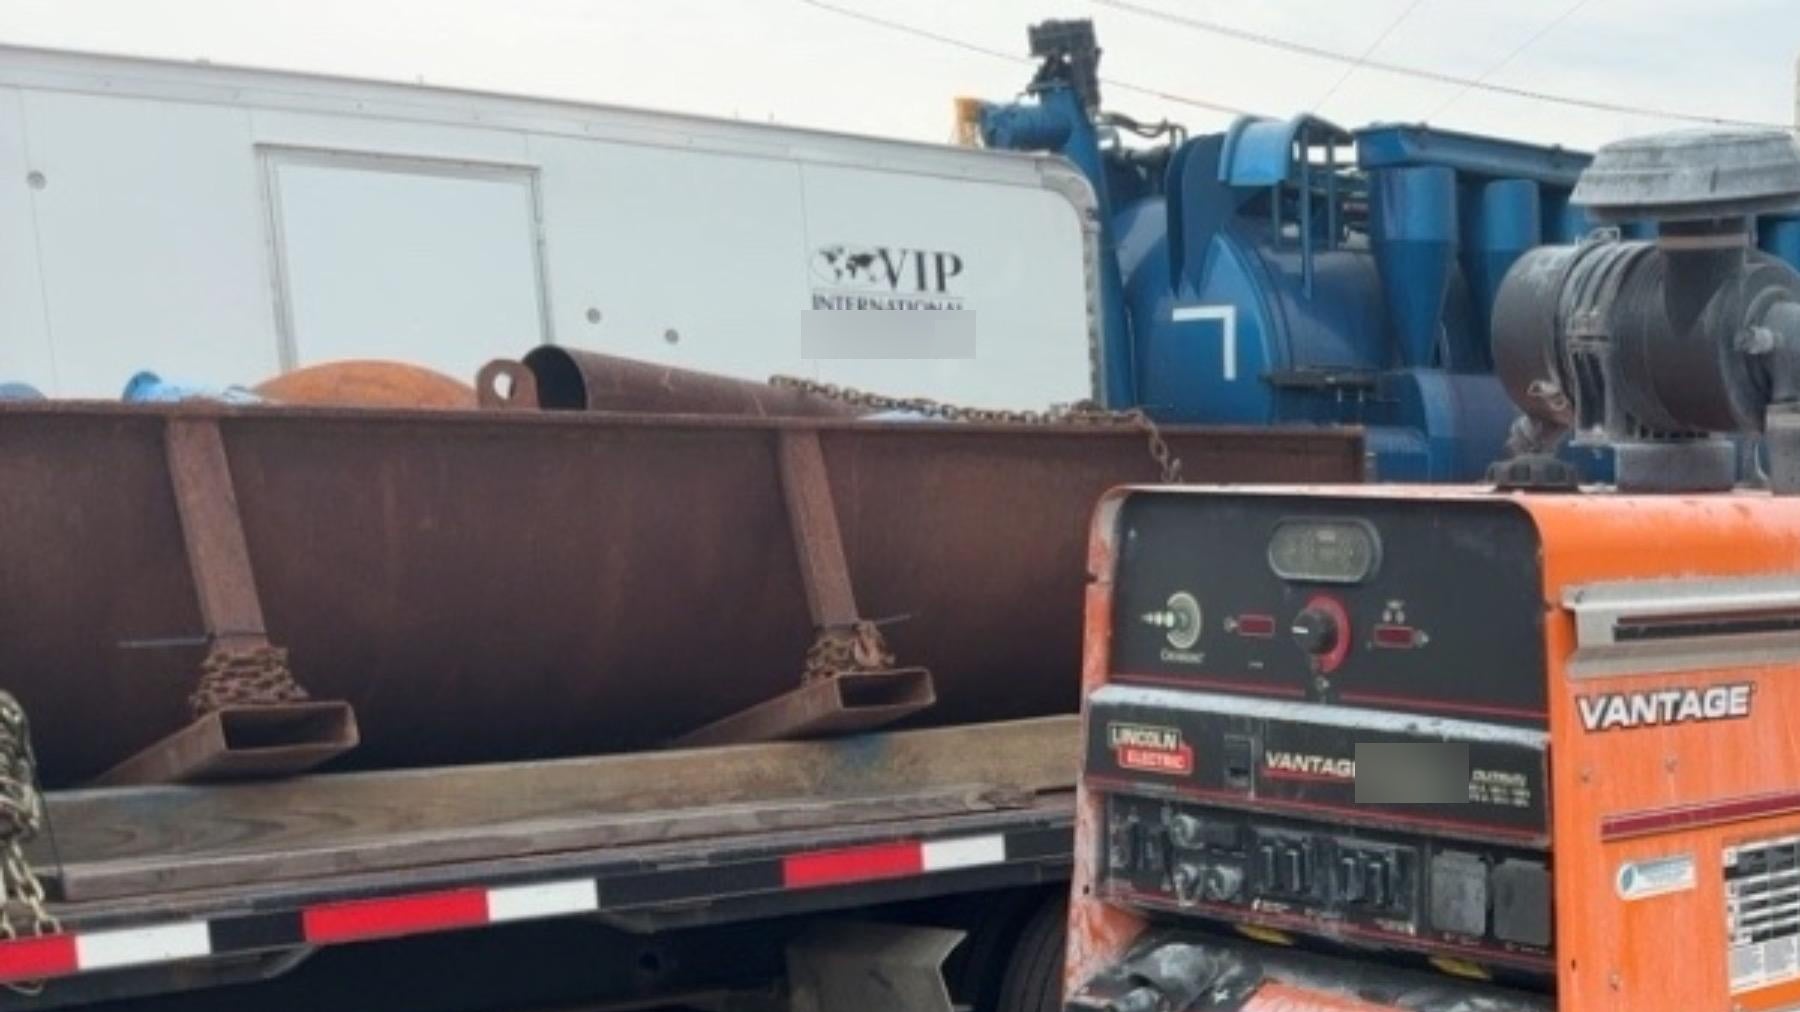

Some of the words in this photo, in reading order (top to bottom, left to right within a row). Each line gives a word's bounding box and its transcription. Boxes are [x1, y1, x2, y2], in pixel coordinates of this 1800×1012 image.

[875, 247, 963, 292] VIP
[1576, 684, 1751, 733] VANTAGE
[1112, 727, 1179, 750] LINCOLN
